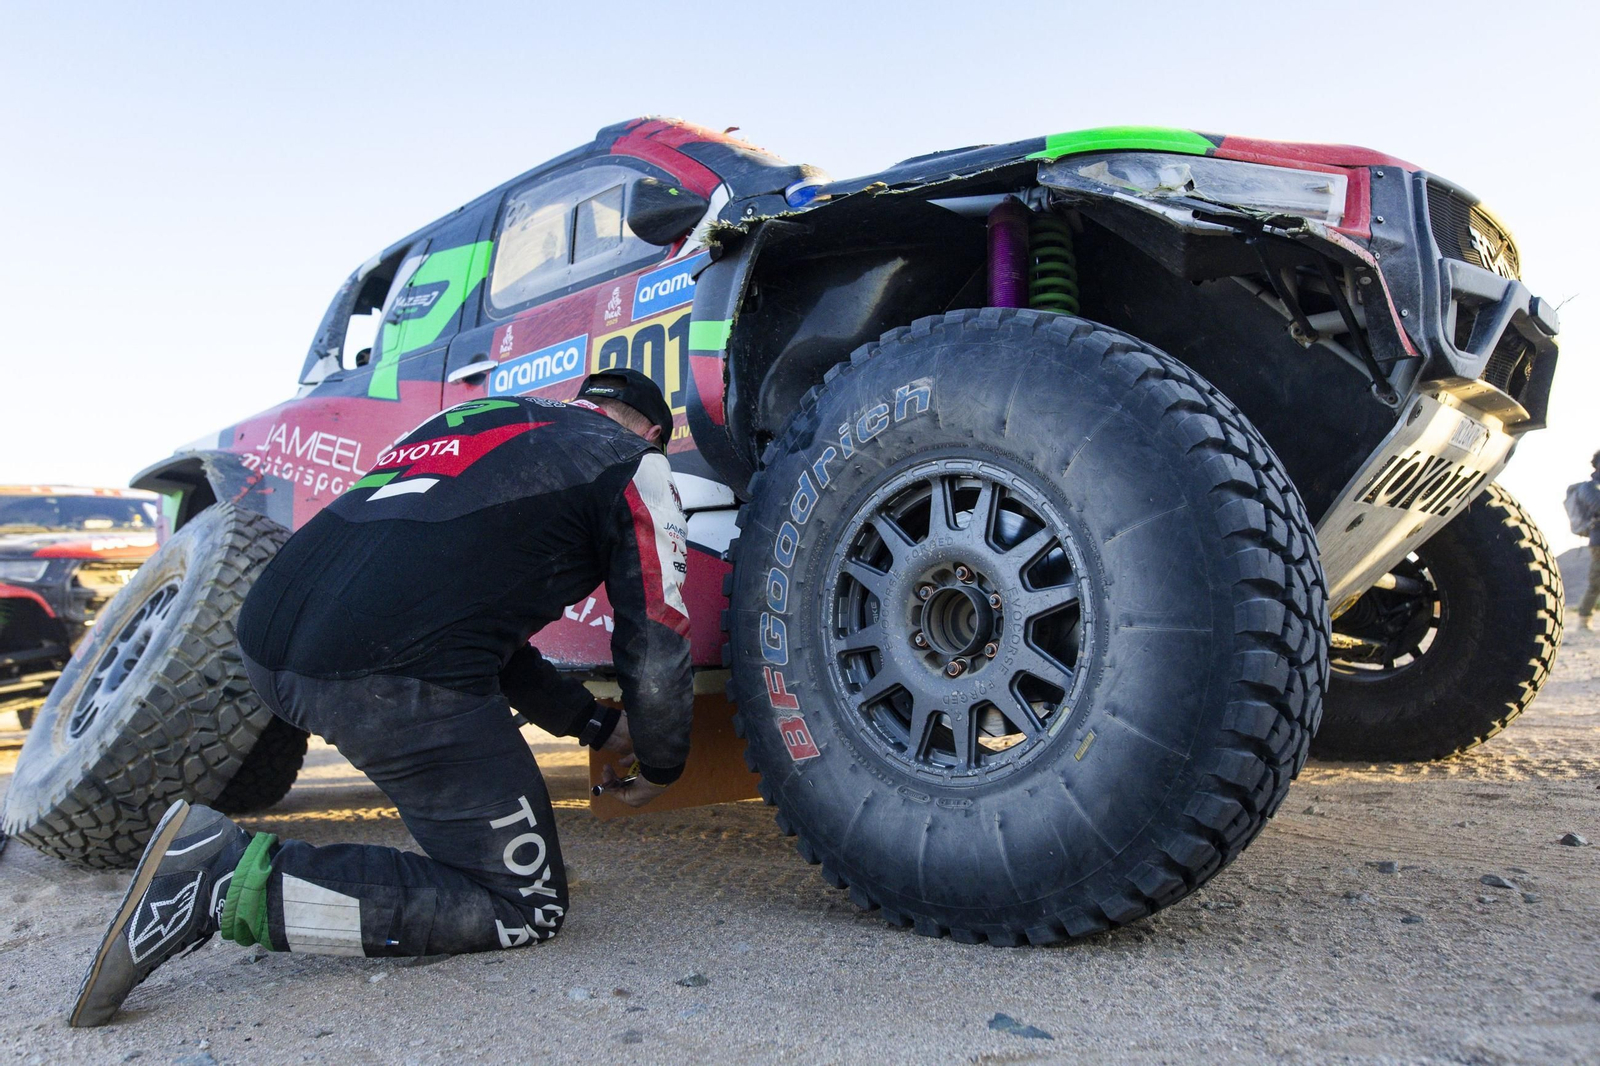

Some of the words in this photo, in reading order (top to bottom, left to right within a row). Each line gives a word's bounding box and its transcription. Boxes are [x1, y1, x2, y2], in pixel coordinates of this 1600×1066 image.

[495, 347, 579, 393] aramco
[256, 423, 367, 476] JAMEEL
[378, 440, 459, 466] OYOTA
[671, 425, 692, 440] LIV
[1353, 450, 1487, 517] TOYOTA
[759, 382, 933, 761] BFGoodrich
[904, 536, 954, 565] FORGED
[880, 569, 902, 651] EVOCORSE
[1000, 587, 1023, 676] EVOCORSE
[943, 681, 996, 706] FORGED
